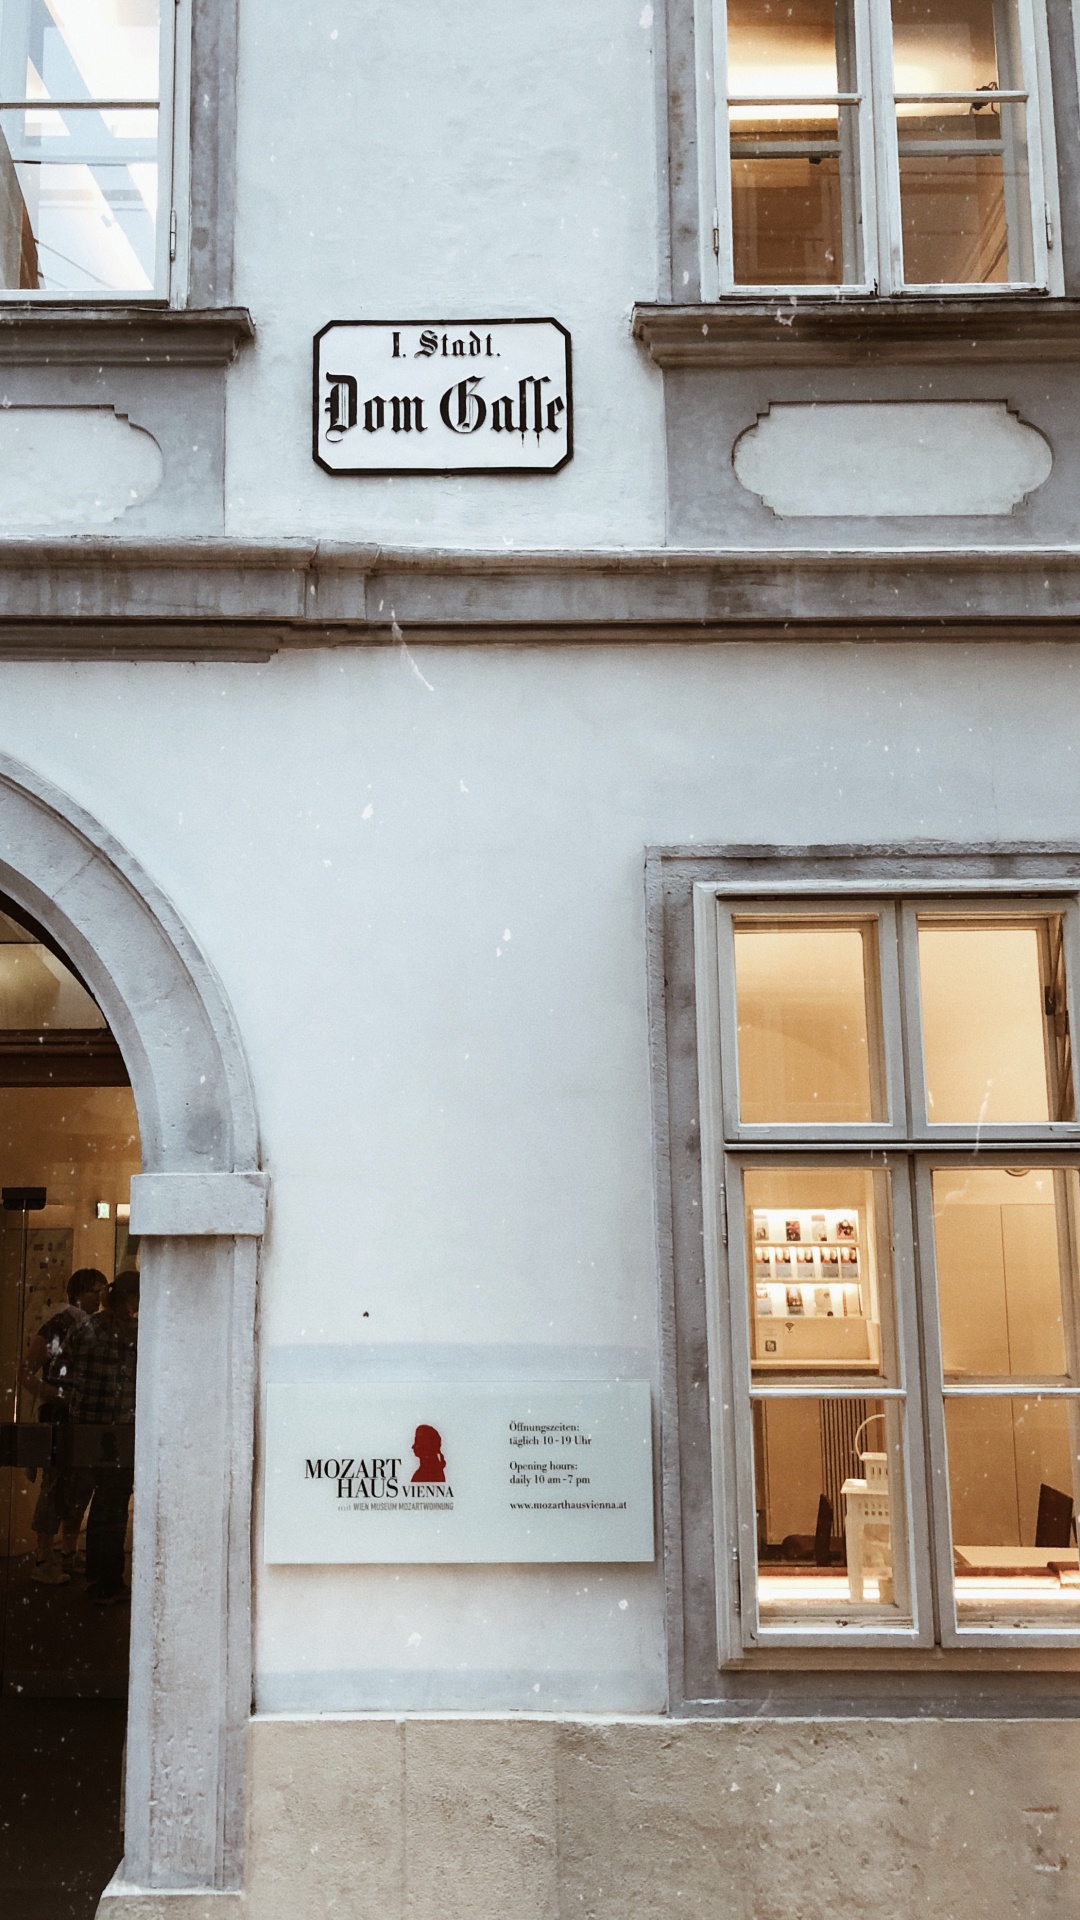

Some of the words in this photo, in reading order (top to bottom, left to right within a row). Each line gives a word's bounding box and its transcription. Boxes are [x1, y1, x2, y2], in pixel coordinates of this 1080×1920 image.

[391, 331, 407, 358] I.
[414, 329, 501, 358] Stadt.
[325, 371, 428, 443] Dom
[509, 1420, 580, 1434] Öffnungszeiten:
[509, 1435, 540, 1448] täglich
[574, 1435, 592, 1446] Uhr
[304, 1458, 402, 1479] MOZART
[509, 1461, 548, 1474] Opening
[549, 1460, 579, 1471] hours:
[509, 1474, 532, 1487] daily
[534, 1475, 545, 1484] 10
[575, 1476, 591, 1487] pm
[336, 1477, 399, 1499] HAUS
[402, 1485, 454, 1498] VIENNA
[353, 1502, 370, 1511] WIEN
[371, 1502, 398, 1511] MUSEUM
[398, 1502, 454, 1511] MOZARTWOHNUNG
[509, 1500, 628, 1511] www.mozarthausvienna.at
